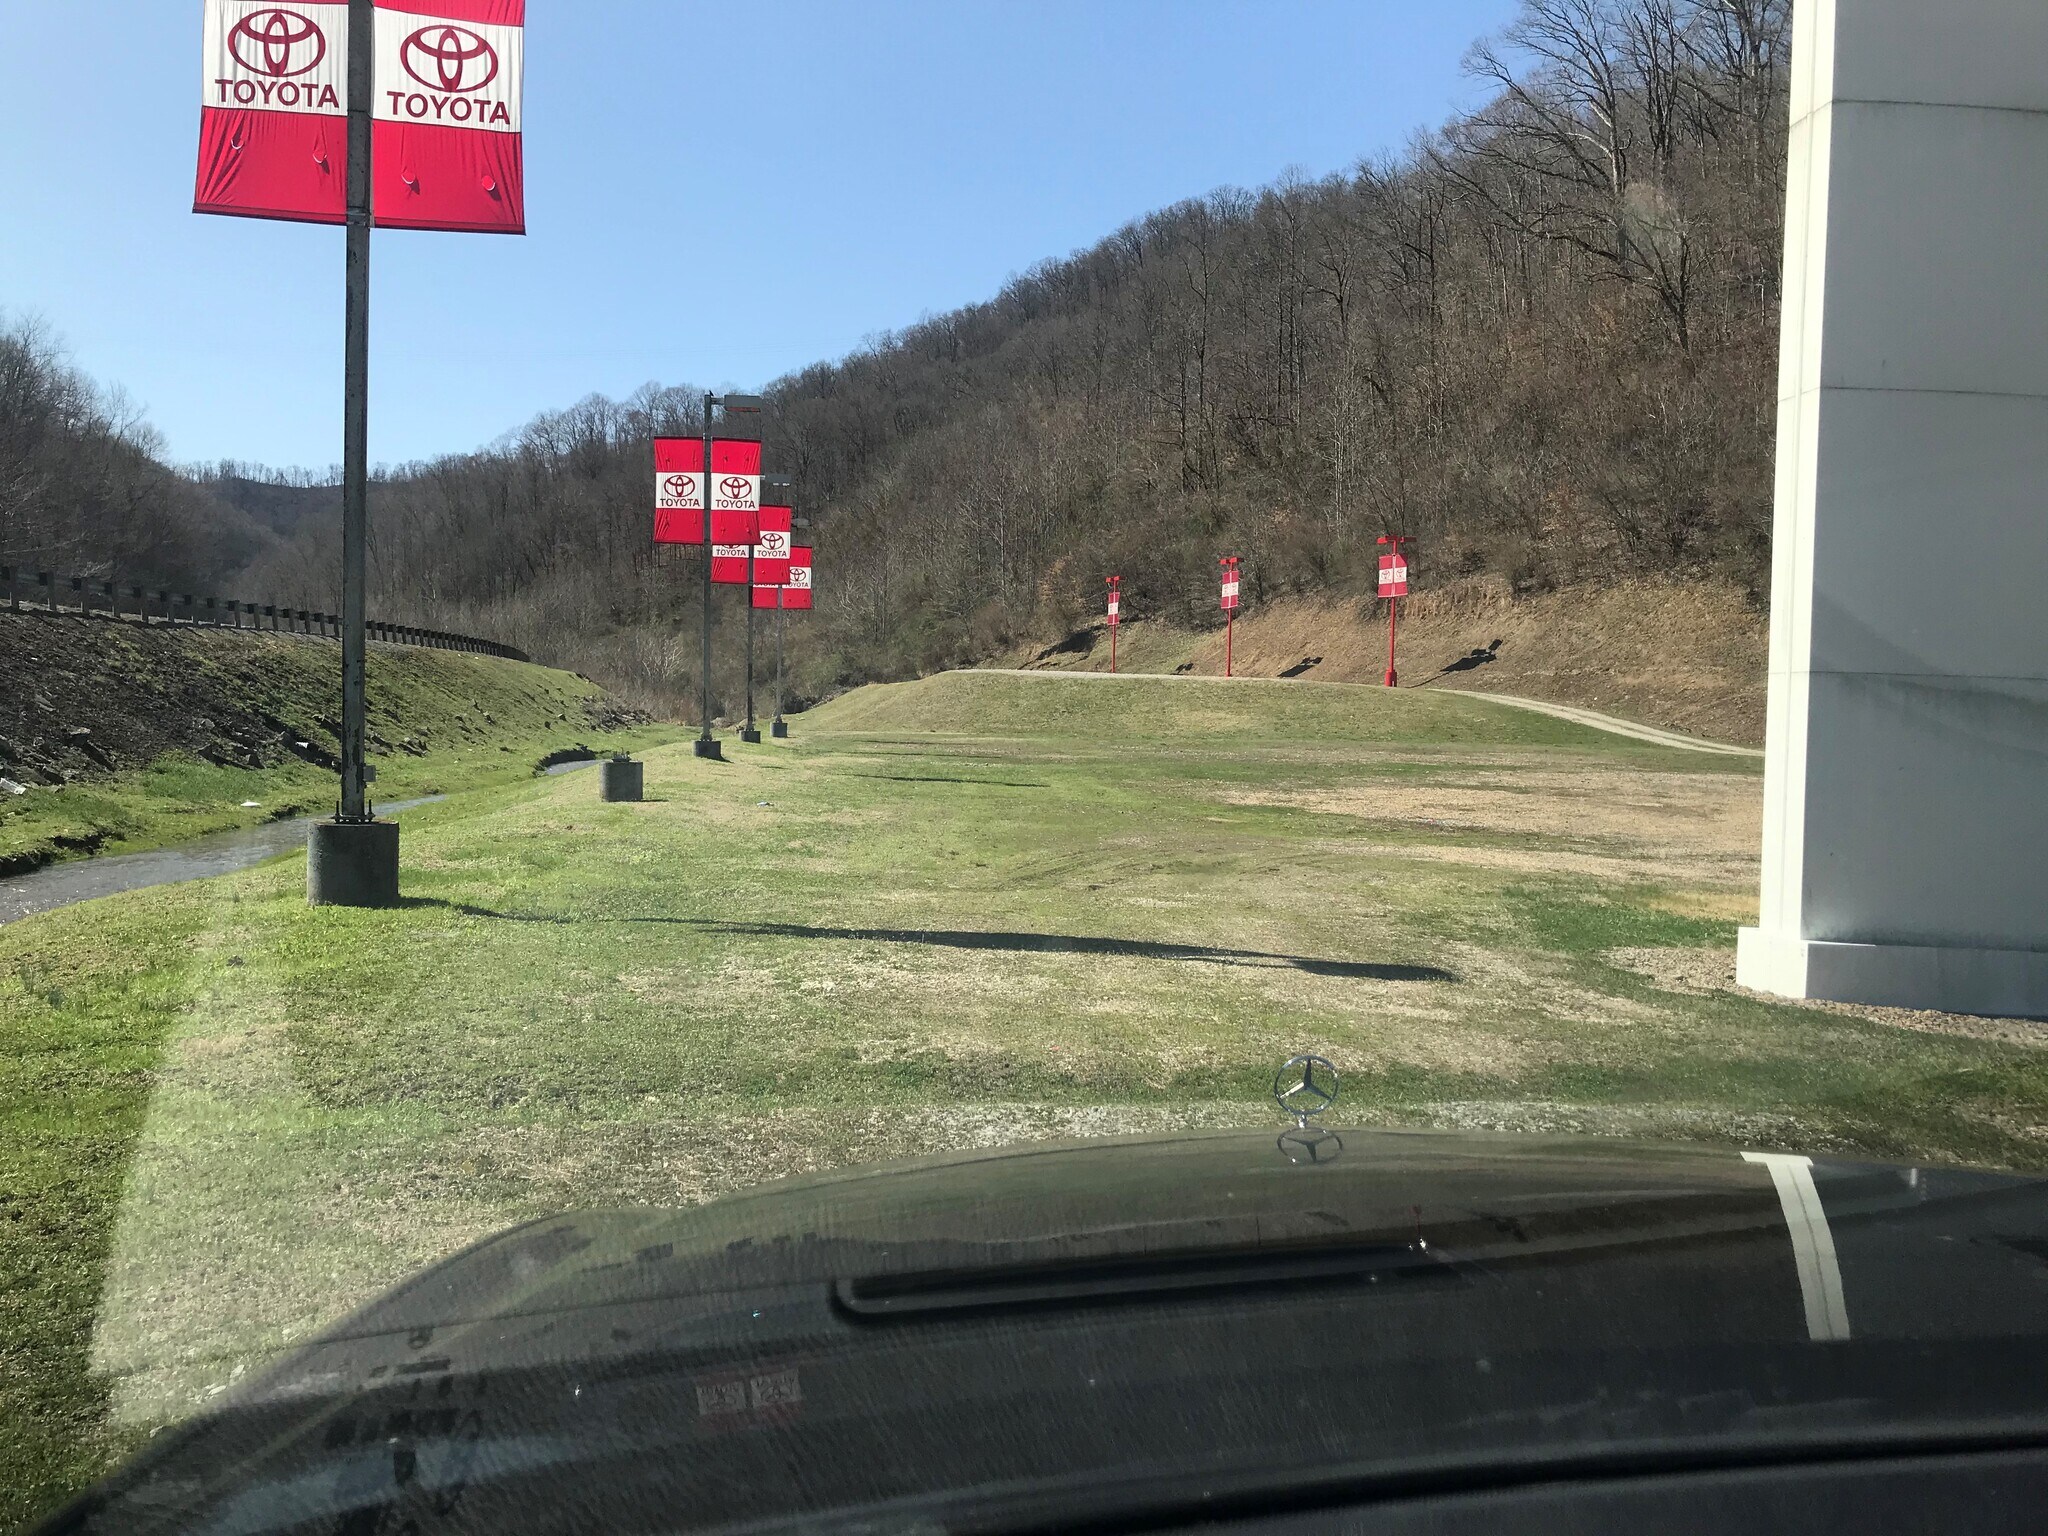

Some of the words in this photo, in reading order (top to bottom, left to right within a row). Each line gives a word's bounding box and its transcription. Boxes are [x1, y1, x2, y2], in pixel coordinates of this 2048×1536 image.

[215, 78, 339, 108] TOYOTA
[387, 90, 511, 125] TOYOTA
[660, 498, 700, 507] TOYOTA
[715, 499, 756, 509] TOYOTA
